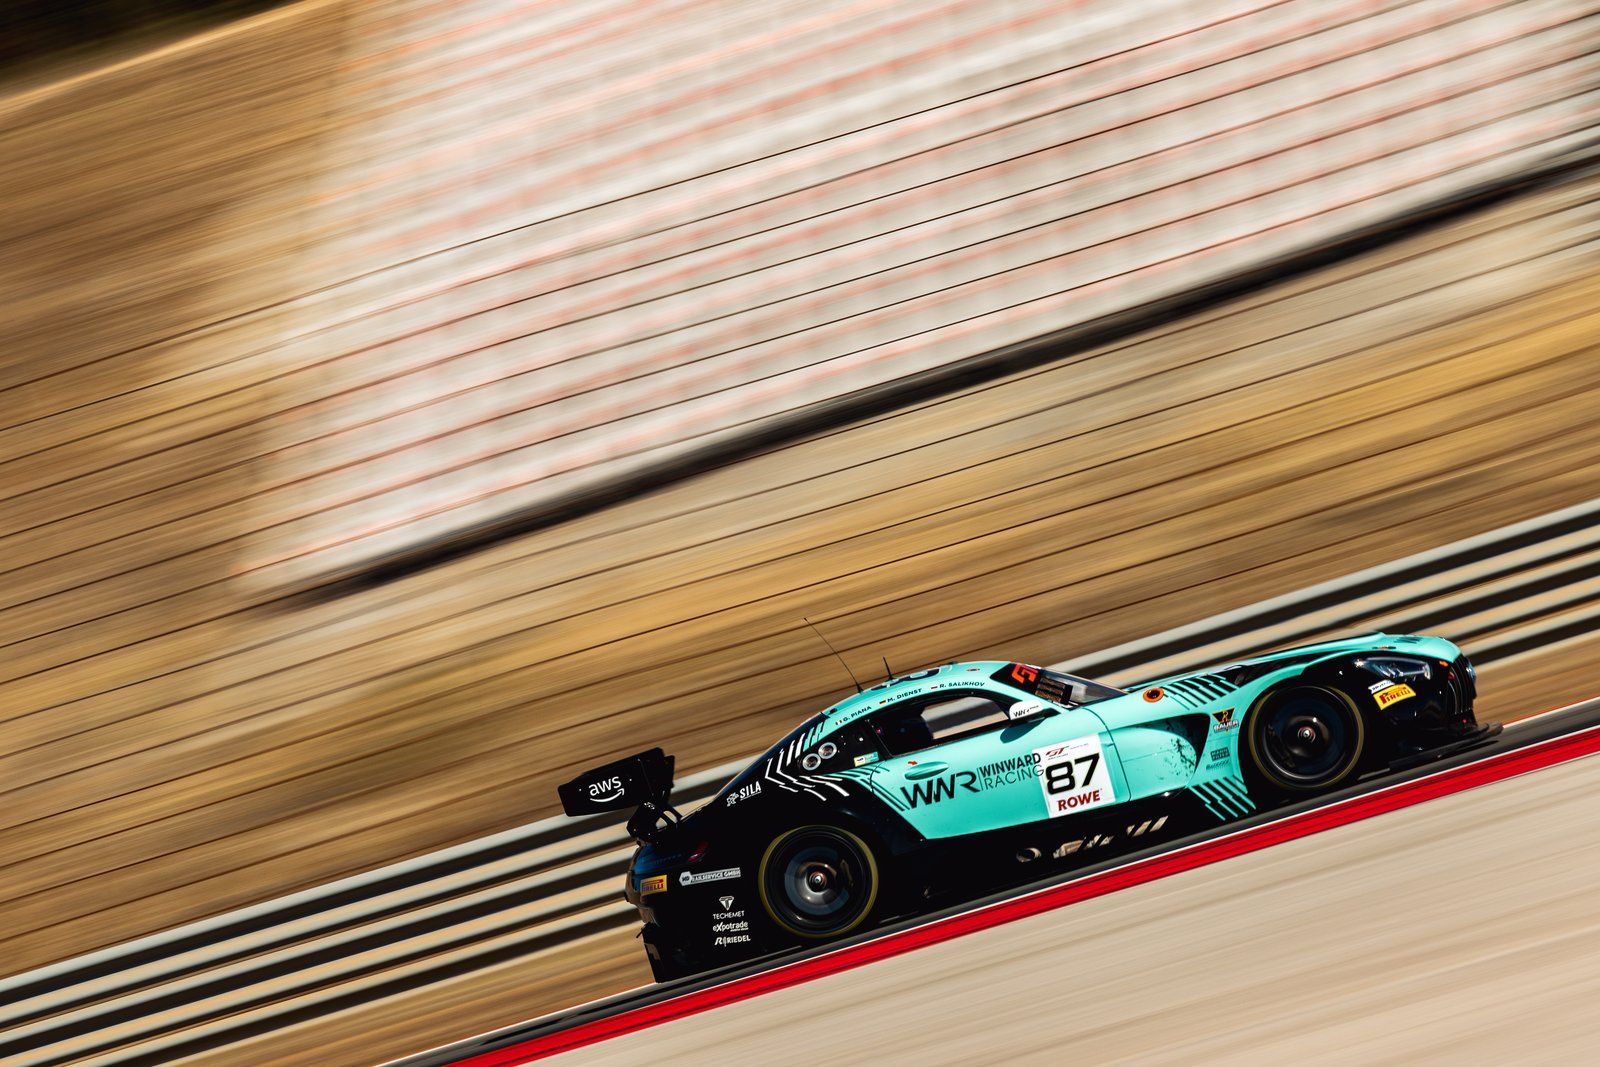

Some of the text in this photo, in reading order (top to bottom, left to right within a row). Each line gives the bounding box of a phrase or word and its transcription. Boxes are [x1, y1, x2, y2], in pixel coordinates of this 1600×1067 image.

[897, 688, 922, 700] DIENST
[1379, 687, 1411, 704] PIRELLI
[852, 706, 872, 718] PIANA
[979, 753, 1041, 778] WINWARD
[1046, 753, 1100, 795] 87
[589, 776, 621, 796] aws
[983, 764, 1044, 790] RACING
[740, 781, 761, 798] SILA
[1057, 790, 1101, 811] ROWE
[712, 911, 745, 919] TECHEMET
